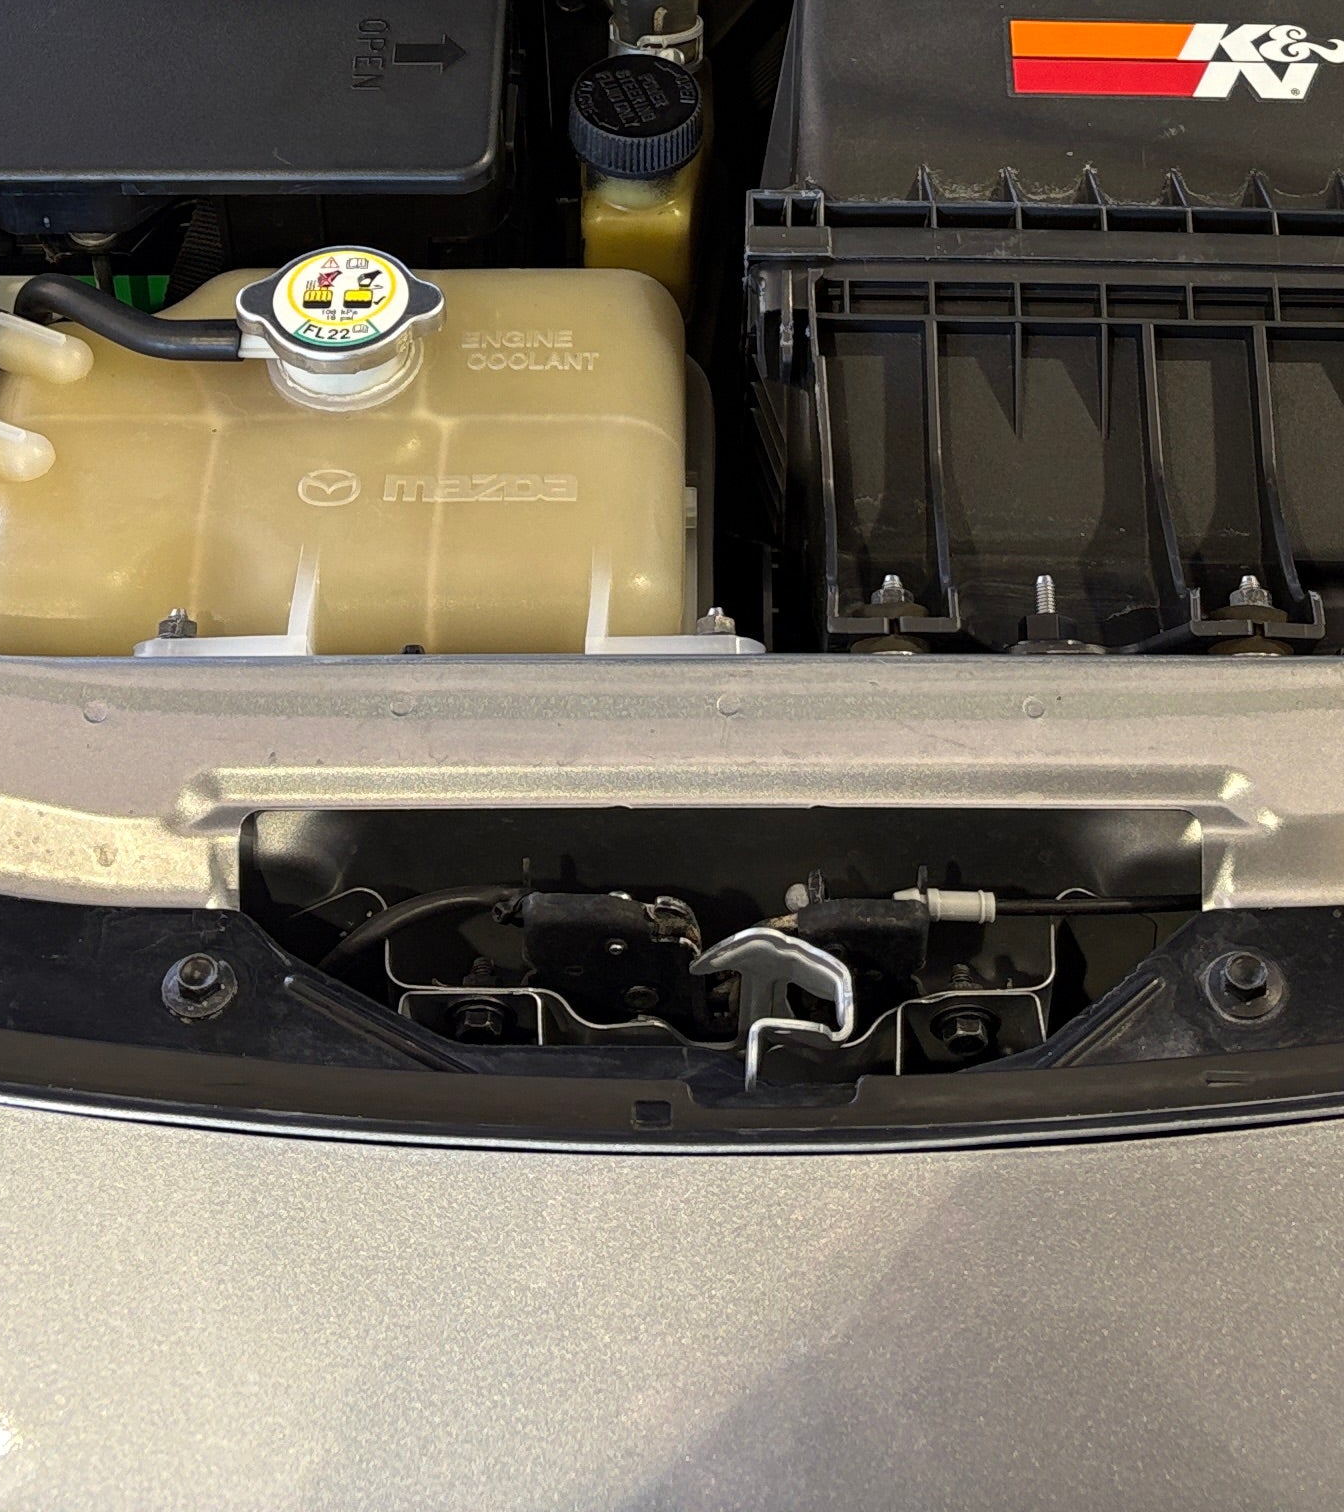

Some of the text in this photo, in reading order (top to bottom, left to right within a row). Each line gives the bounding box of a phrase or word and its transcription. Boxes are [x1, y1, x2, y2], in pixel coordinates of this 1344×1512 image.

[350, 18, 391, 91] OPEN
[615, 68, 657, 124] STEERING
[302, 323, 352, 341] FL22
[461, 329, 574, 349] ENGINE
[467, 351, 600, 371] COOLANT
